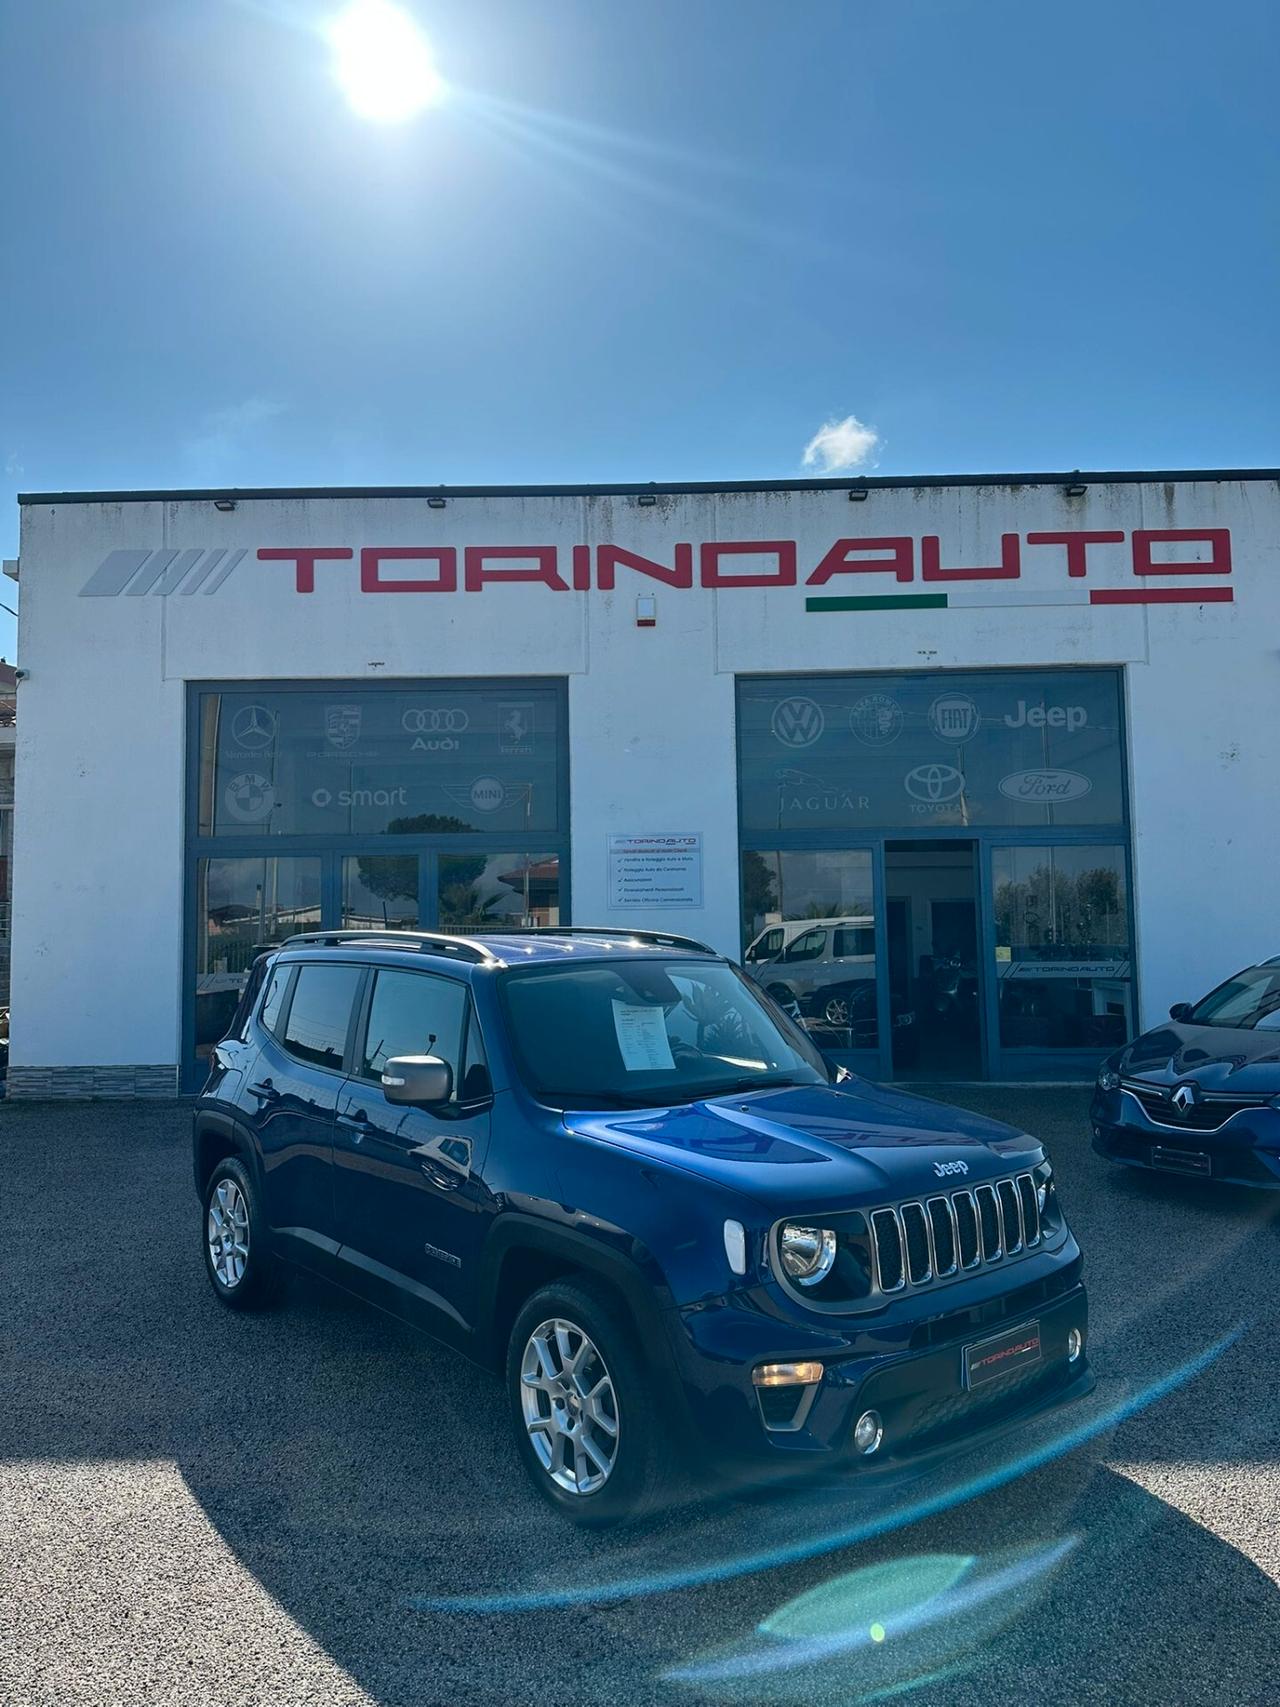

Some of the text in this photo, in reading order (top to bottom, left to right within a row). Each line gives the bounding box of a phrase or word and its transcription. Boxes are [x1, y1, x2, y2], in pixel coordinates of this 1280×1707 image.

[257, 528, 1232, 592] TORINOAUTO
[941, 708, 969, 730] FIAT
[1004, 699, 1088, 732] Jeep
[410, 737, 460, 750] Audi
[472, 789, 502, 801] MINI
[1017, 775, 1073, 796] Ford
[337, 787, 408, 806] smart
[780, 796, 870, 811] JAGUAR
[932, 1160, 969, 1178] Jeep
